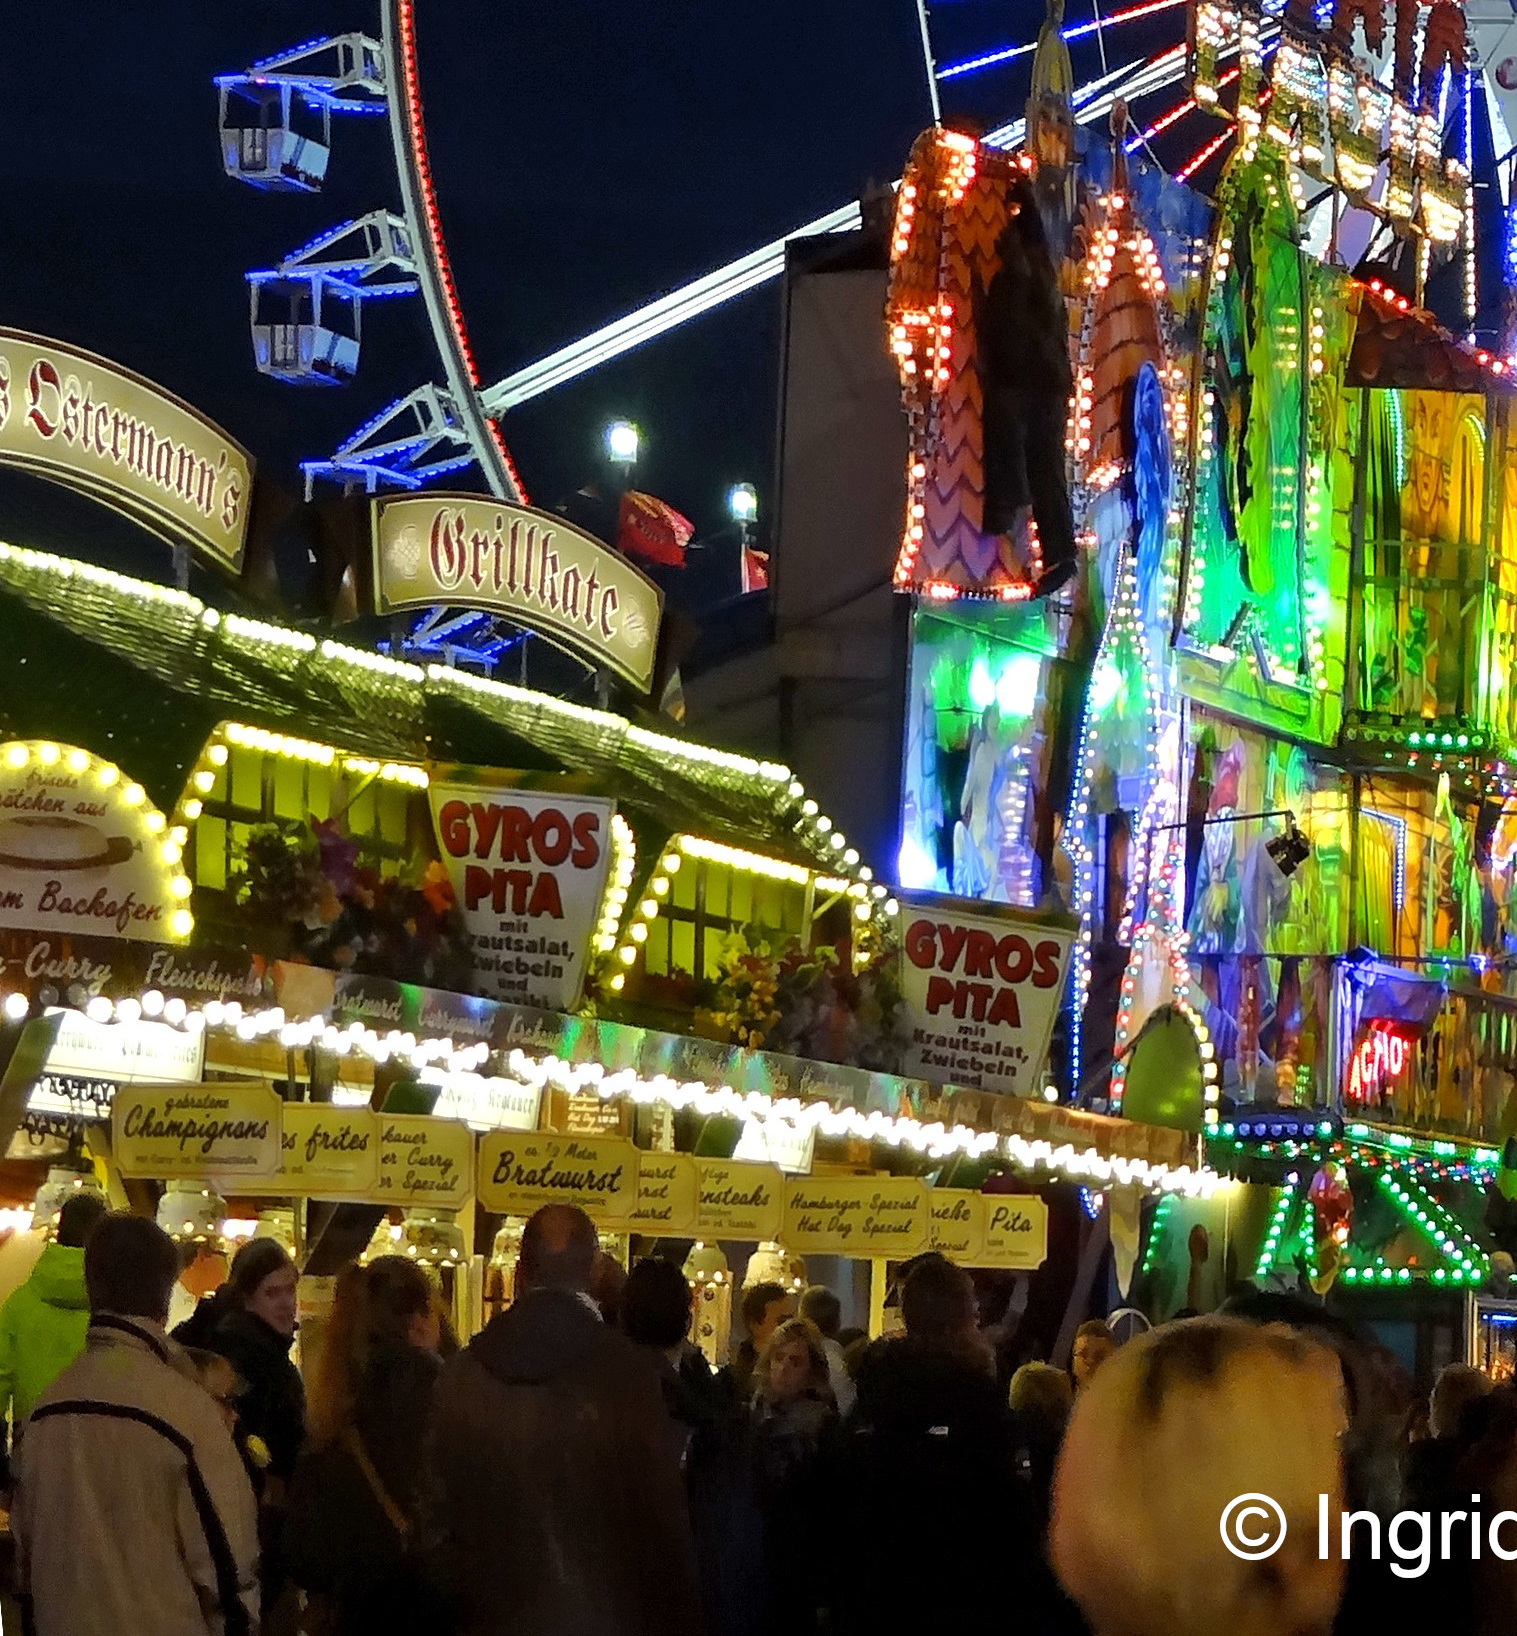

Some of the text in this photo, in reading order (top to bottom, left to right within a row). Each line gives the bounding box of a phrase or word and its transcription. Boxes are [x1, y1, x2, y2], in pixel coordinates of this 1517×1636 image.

[26, 358, 244, 533] Ostermann's
[428, 506, 620, 642] Grillkate
[439, 800, 600, 870] GYROS
[37, 879, 163, 933] Backofen
[464, 865, 565, 919] PITA
[500, 918, 529, 934] mit
[905, 919, 1062, 989] GYROS
[925, 976, 1022, 1029] PITA
[912, 1027, 1030, 1065] Krautsalat,
[957, 1024, 986, 1038] mit
[920, 1048, 1018, 1077] Zwiebeln
[123, 1104, 270, 1154] Champignons
[304, 1123, 370, 1163] frites
[406, 1146, 455, 1176] Curry
[492, 1150, 624, 1194] Bratwurst
[401, 1170, 460, 1197] Spezial
[790, 1192, 920, 1216] Hamburger Spezial
[990, 1206, 1033, 1233] Pita
[797, 1215, 822, 1232] Hot
[827, 1216, 853, 1239] Dog
[862, 1216, 913, 1238] Spezial
